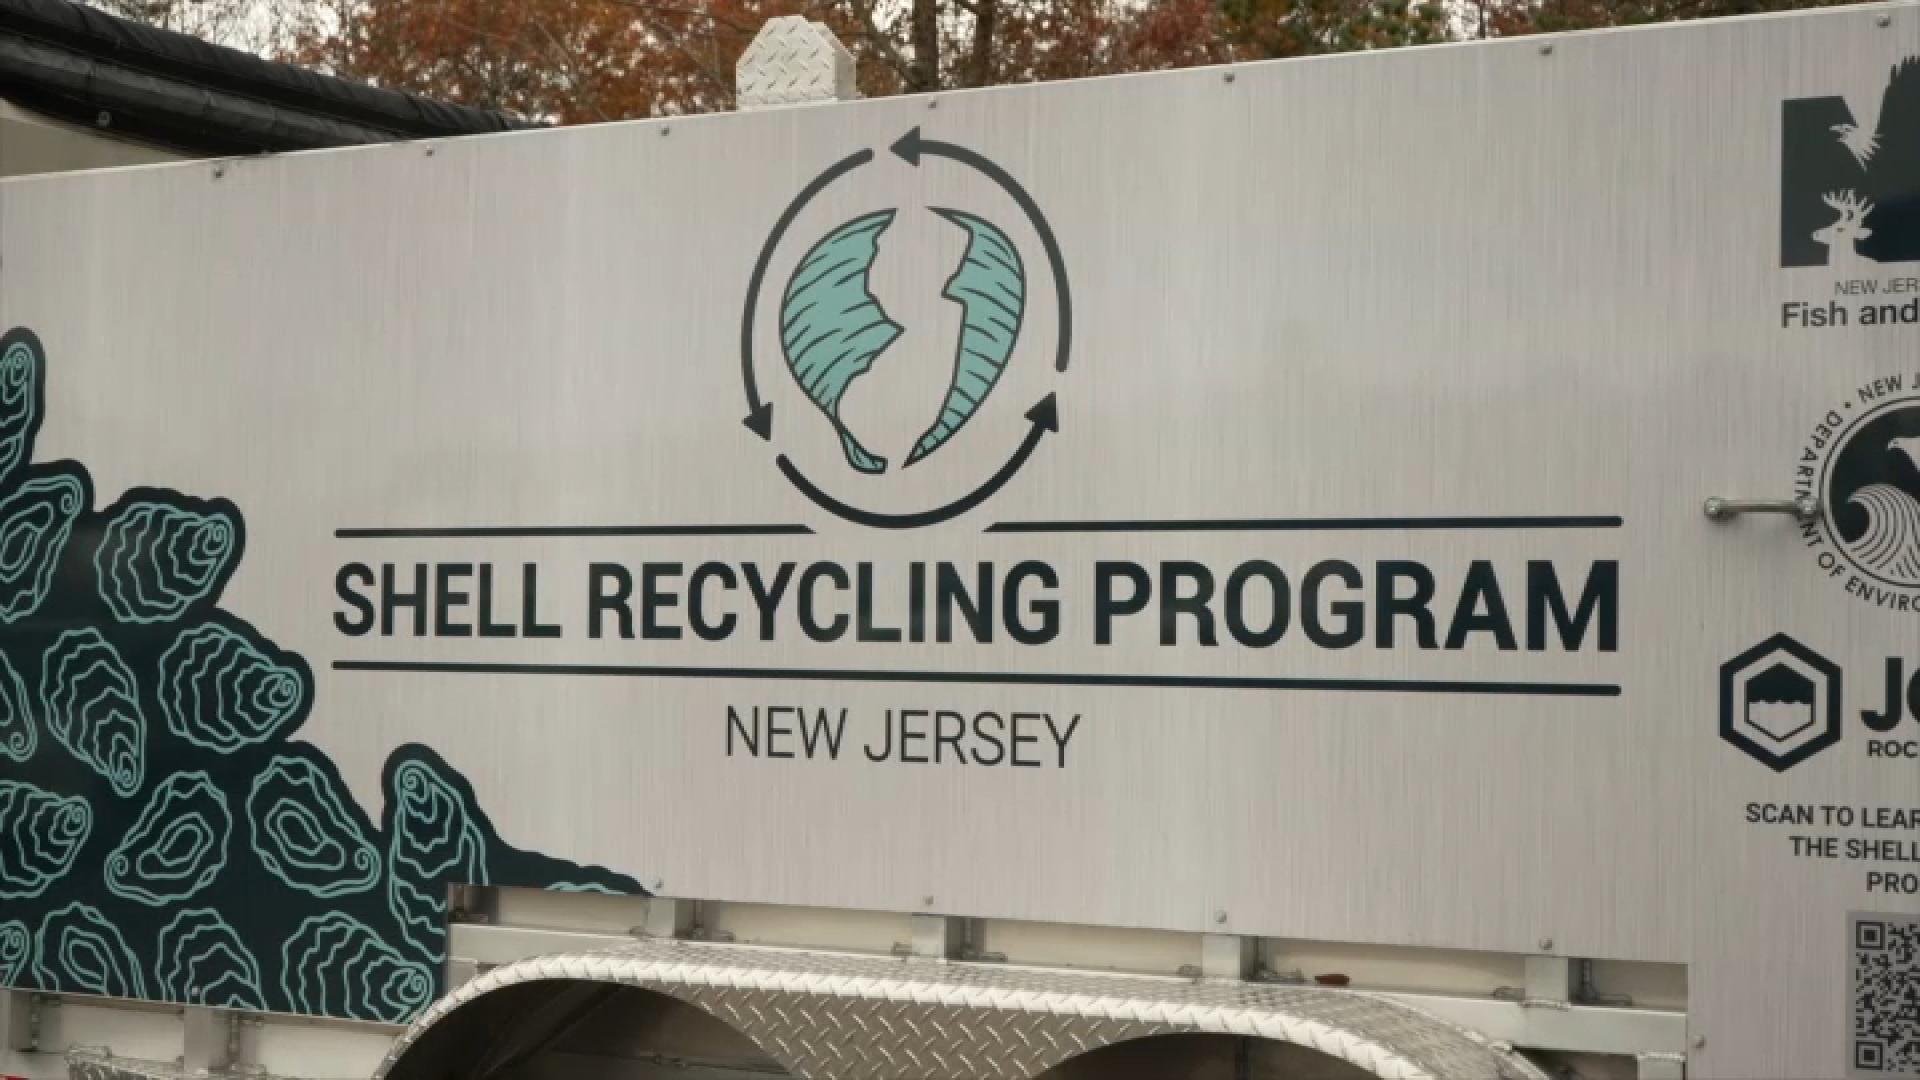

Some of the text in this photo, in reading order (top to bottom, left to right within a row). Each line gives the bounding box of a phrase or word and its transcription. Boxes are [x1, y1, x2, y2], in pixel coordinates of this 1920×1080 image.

[1835, 280, 1877, 294] NEW
[1782, 298, 1918, 328] Fish and
[1858, 374, 1903, 404] NEW
[1818, 551, 1846, 578] OF
[333, 560, 1619, 652] SHELL RECYCLING PROGRAM
[728, 706, 1080, 768] NEW JERSEY
[1747, 802, 1813, 824] SCAN
[1821, 806, 1853, 826] TO
[1789, 836, 1837, 858] THE
